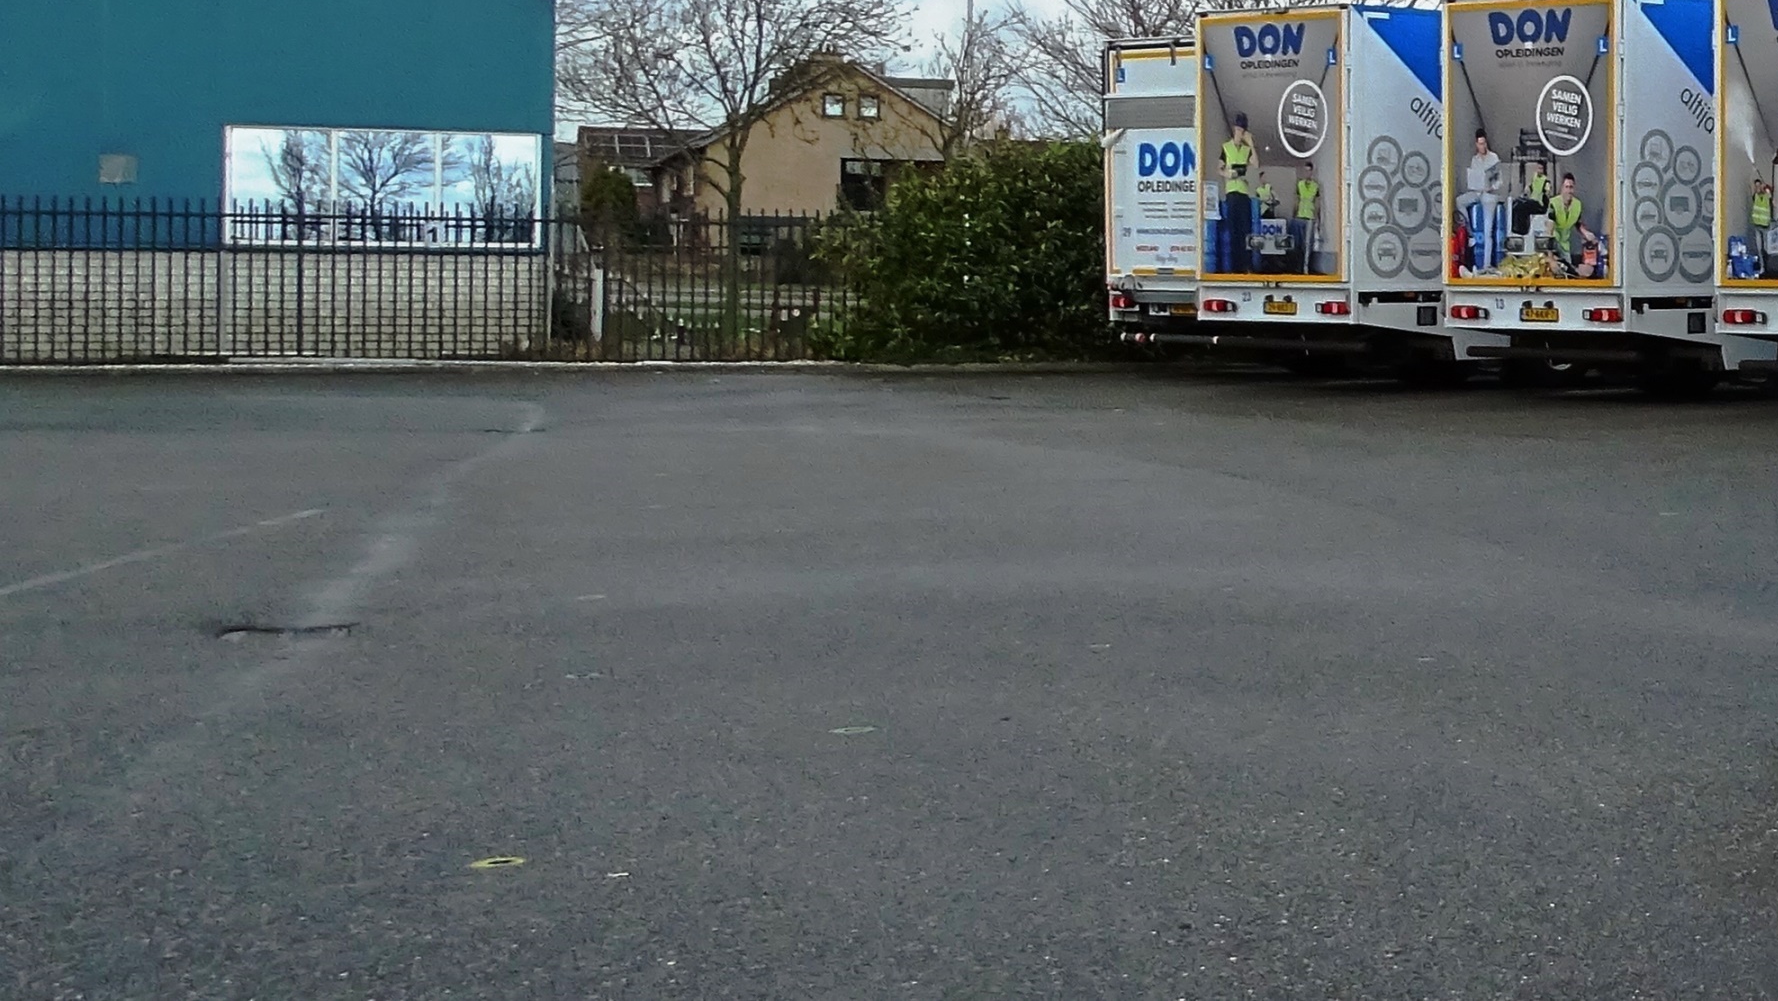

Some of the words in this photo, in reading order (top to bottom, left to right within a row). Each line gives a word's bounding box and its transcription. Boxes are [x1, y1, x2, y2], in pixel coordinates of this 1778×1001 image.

[1488, 7, 1572, 46] DON
[1233, 22, 1306, 58] DON
[1495, 46, 1565, 59] OPLEIDINGEN
[1551, 89, 1582, 105] SAMEN
[1552, 102, 1578, 116] VEILIG
[1546, 112, 1581, 129] WERKEN
[1138, 142, 1196, 177] DON
